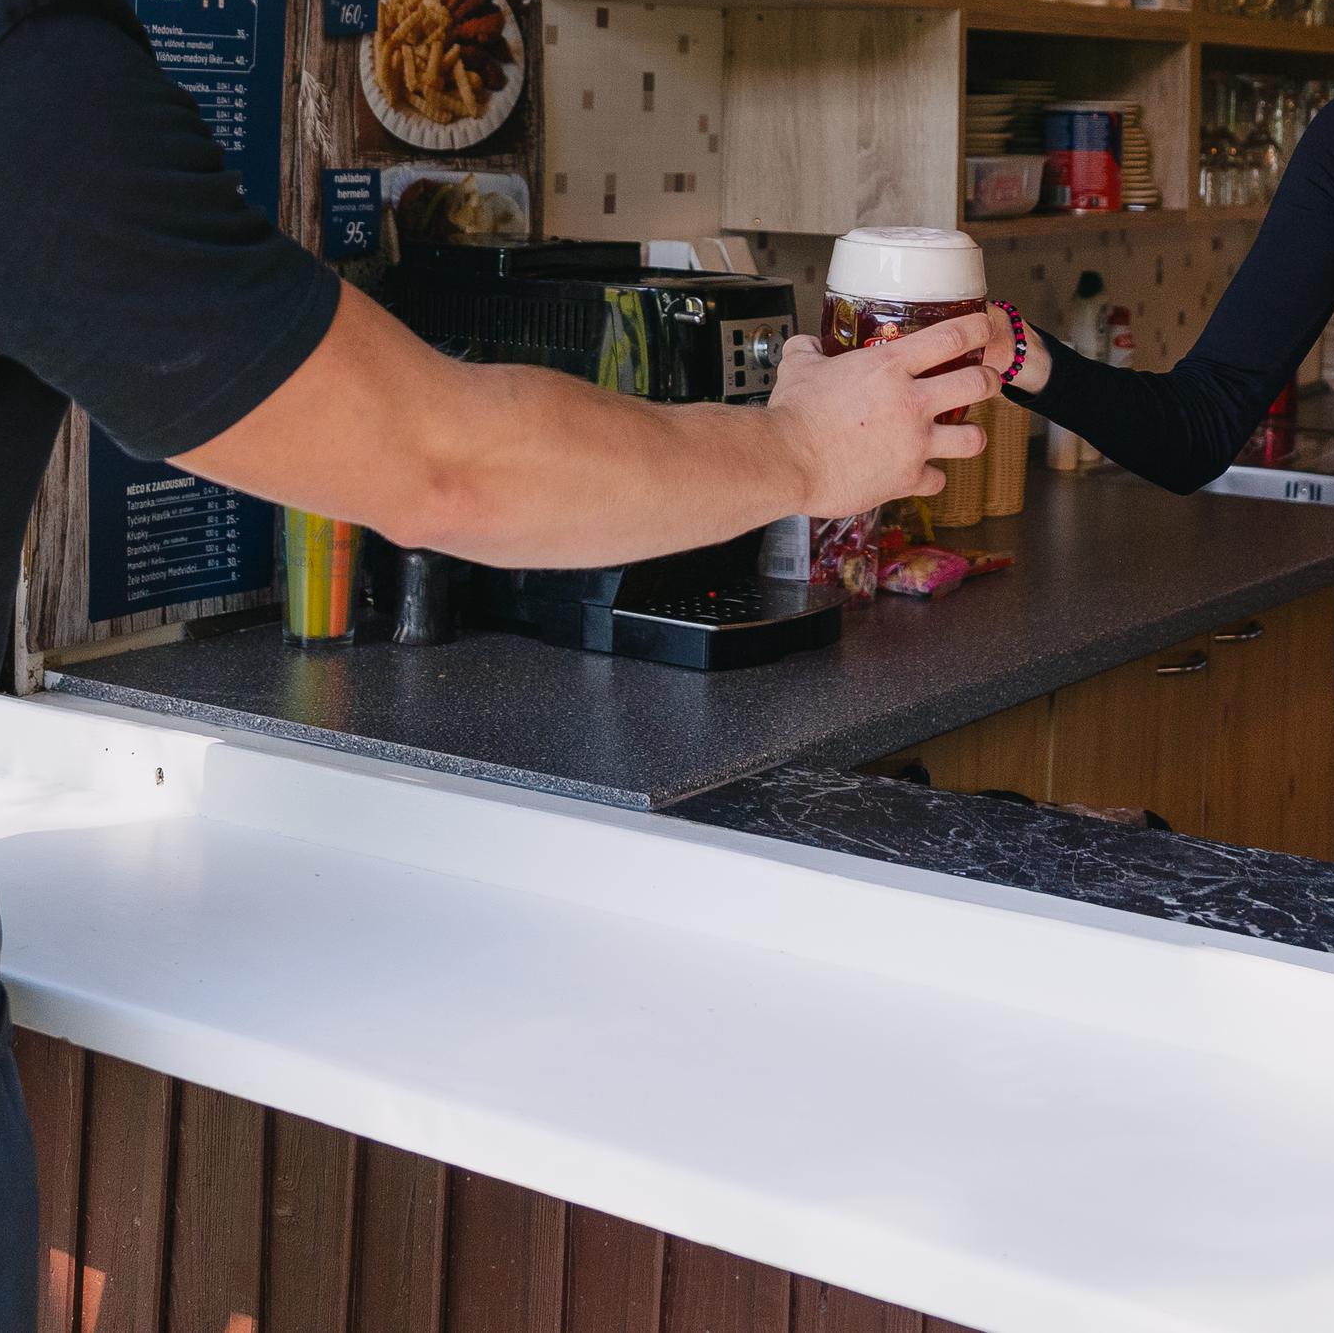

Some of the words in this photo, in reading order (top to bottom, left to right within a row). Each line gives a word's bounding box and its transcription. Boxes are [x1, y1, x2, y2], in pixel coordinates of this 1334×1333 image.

[340, 3, 367, 29] 160,-
[151, 24, 183, 35] Medovina
[343, 221, 371, 247] 95,-
